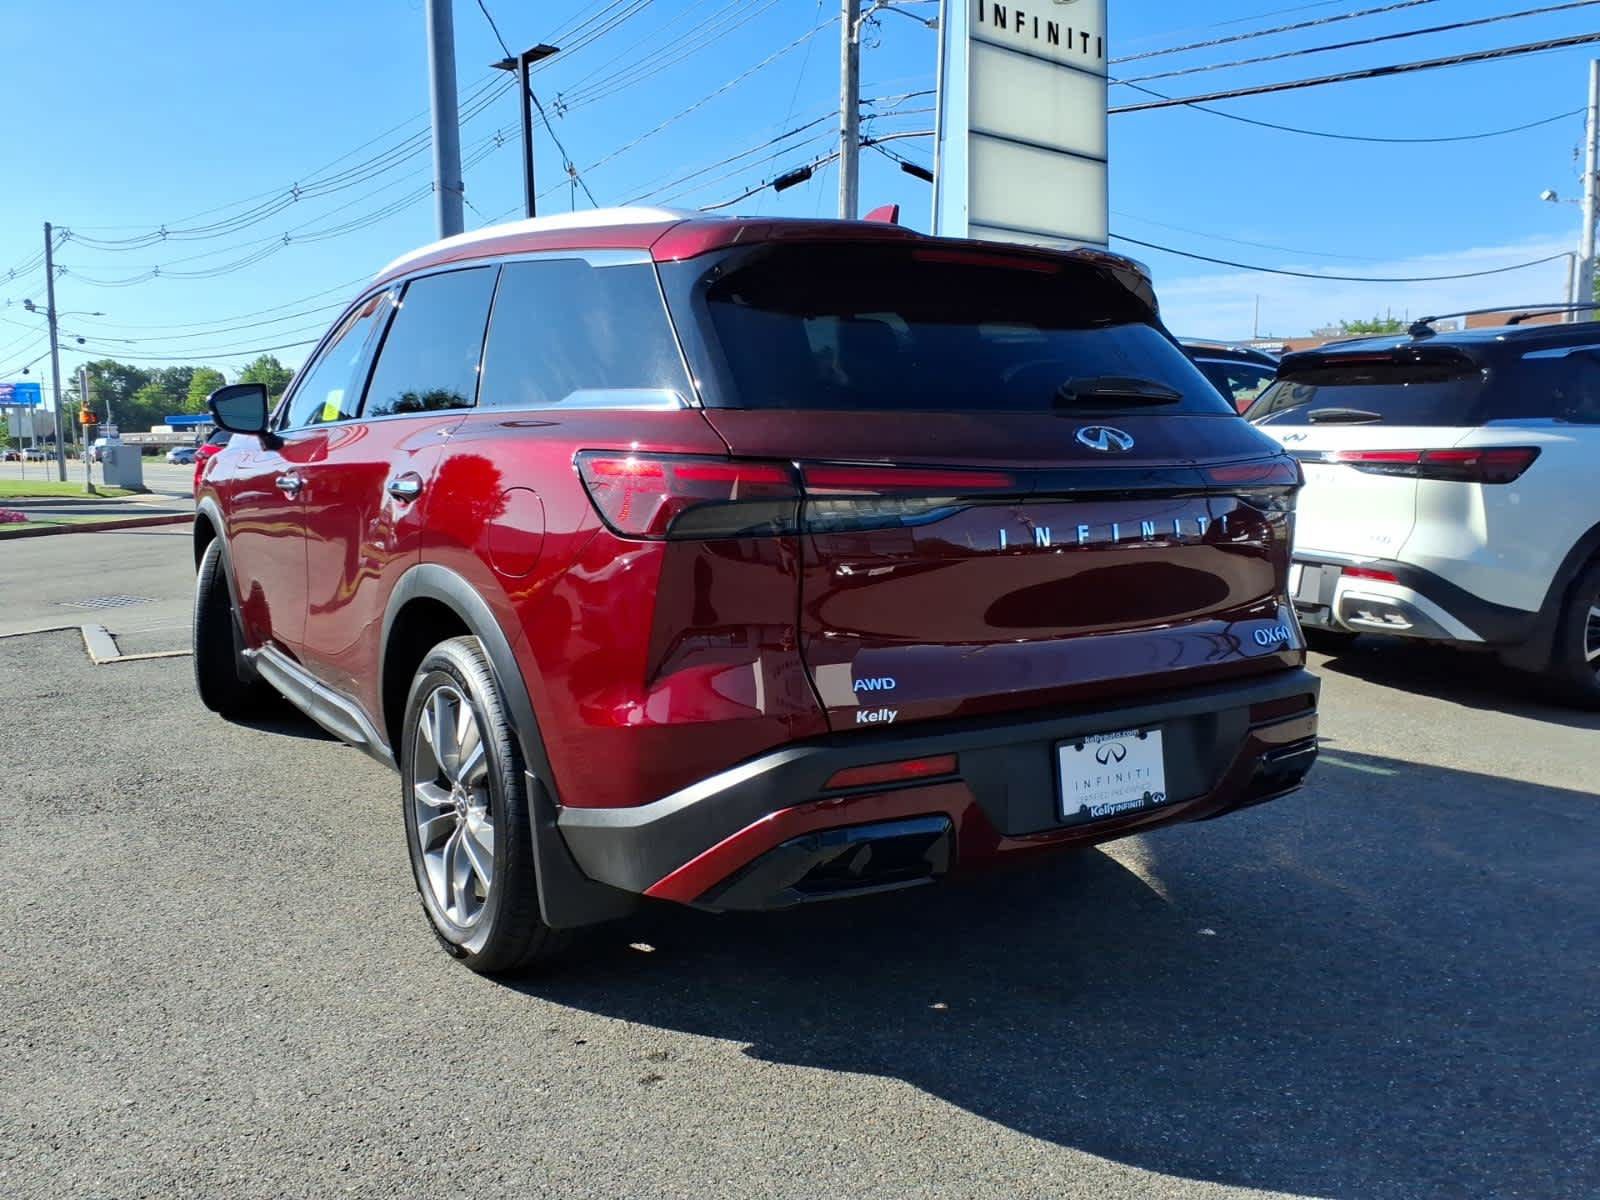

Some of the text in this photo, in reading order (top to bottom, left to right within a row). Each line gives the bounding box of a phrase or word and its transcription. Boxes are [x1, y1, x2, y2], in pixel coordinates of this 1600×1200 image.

[979, 0, 1102, 58] INFINITI
[999, 515, 1229, 550] INFINITI
[853, 677, 896, 692] AWD
[856, 708, 898, 724] Kelly
[1074, 767, 1150, 793] INFINITI
